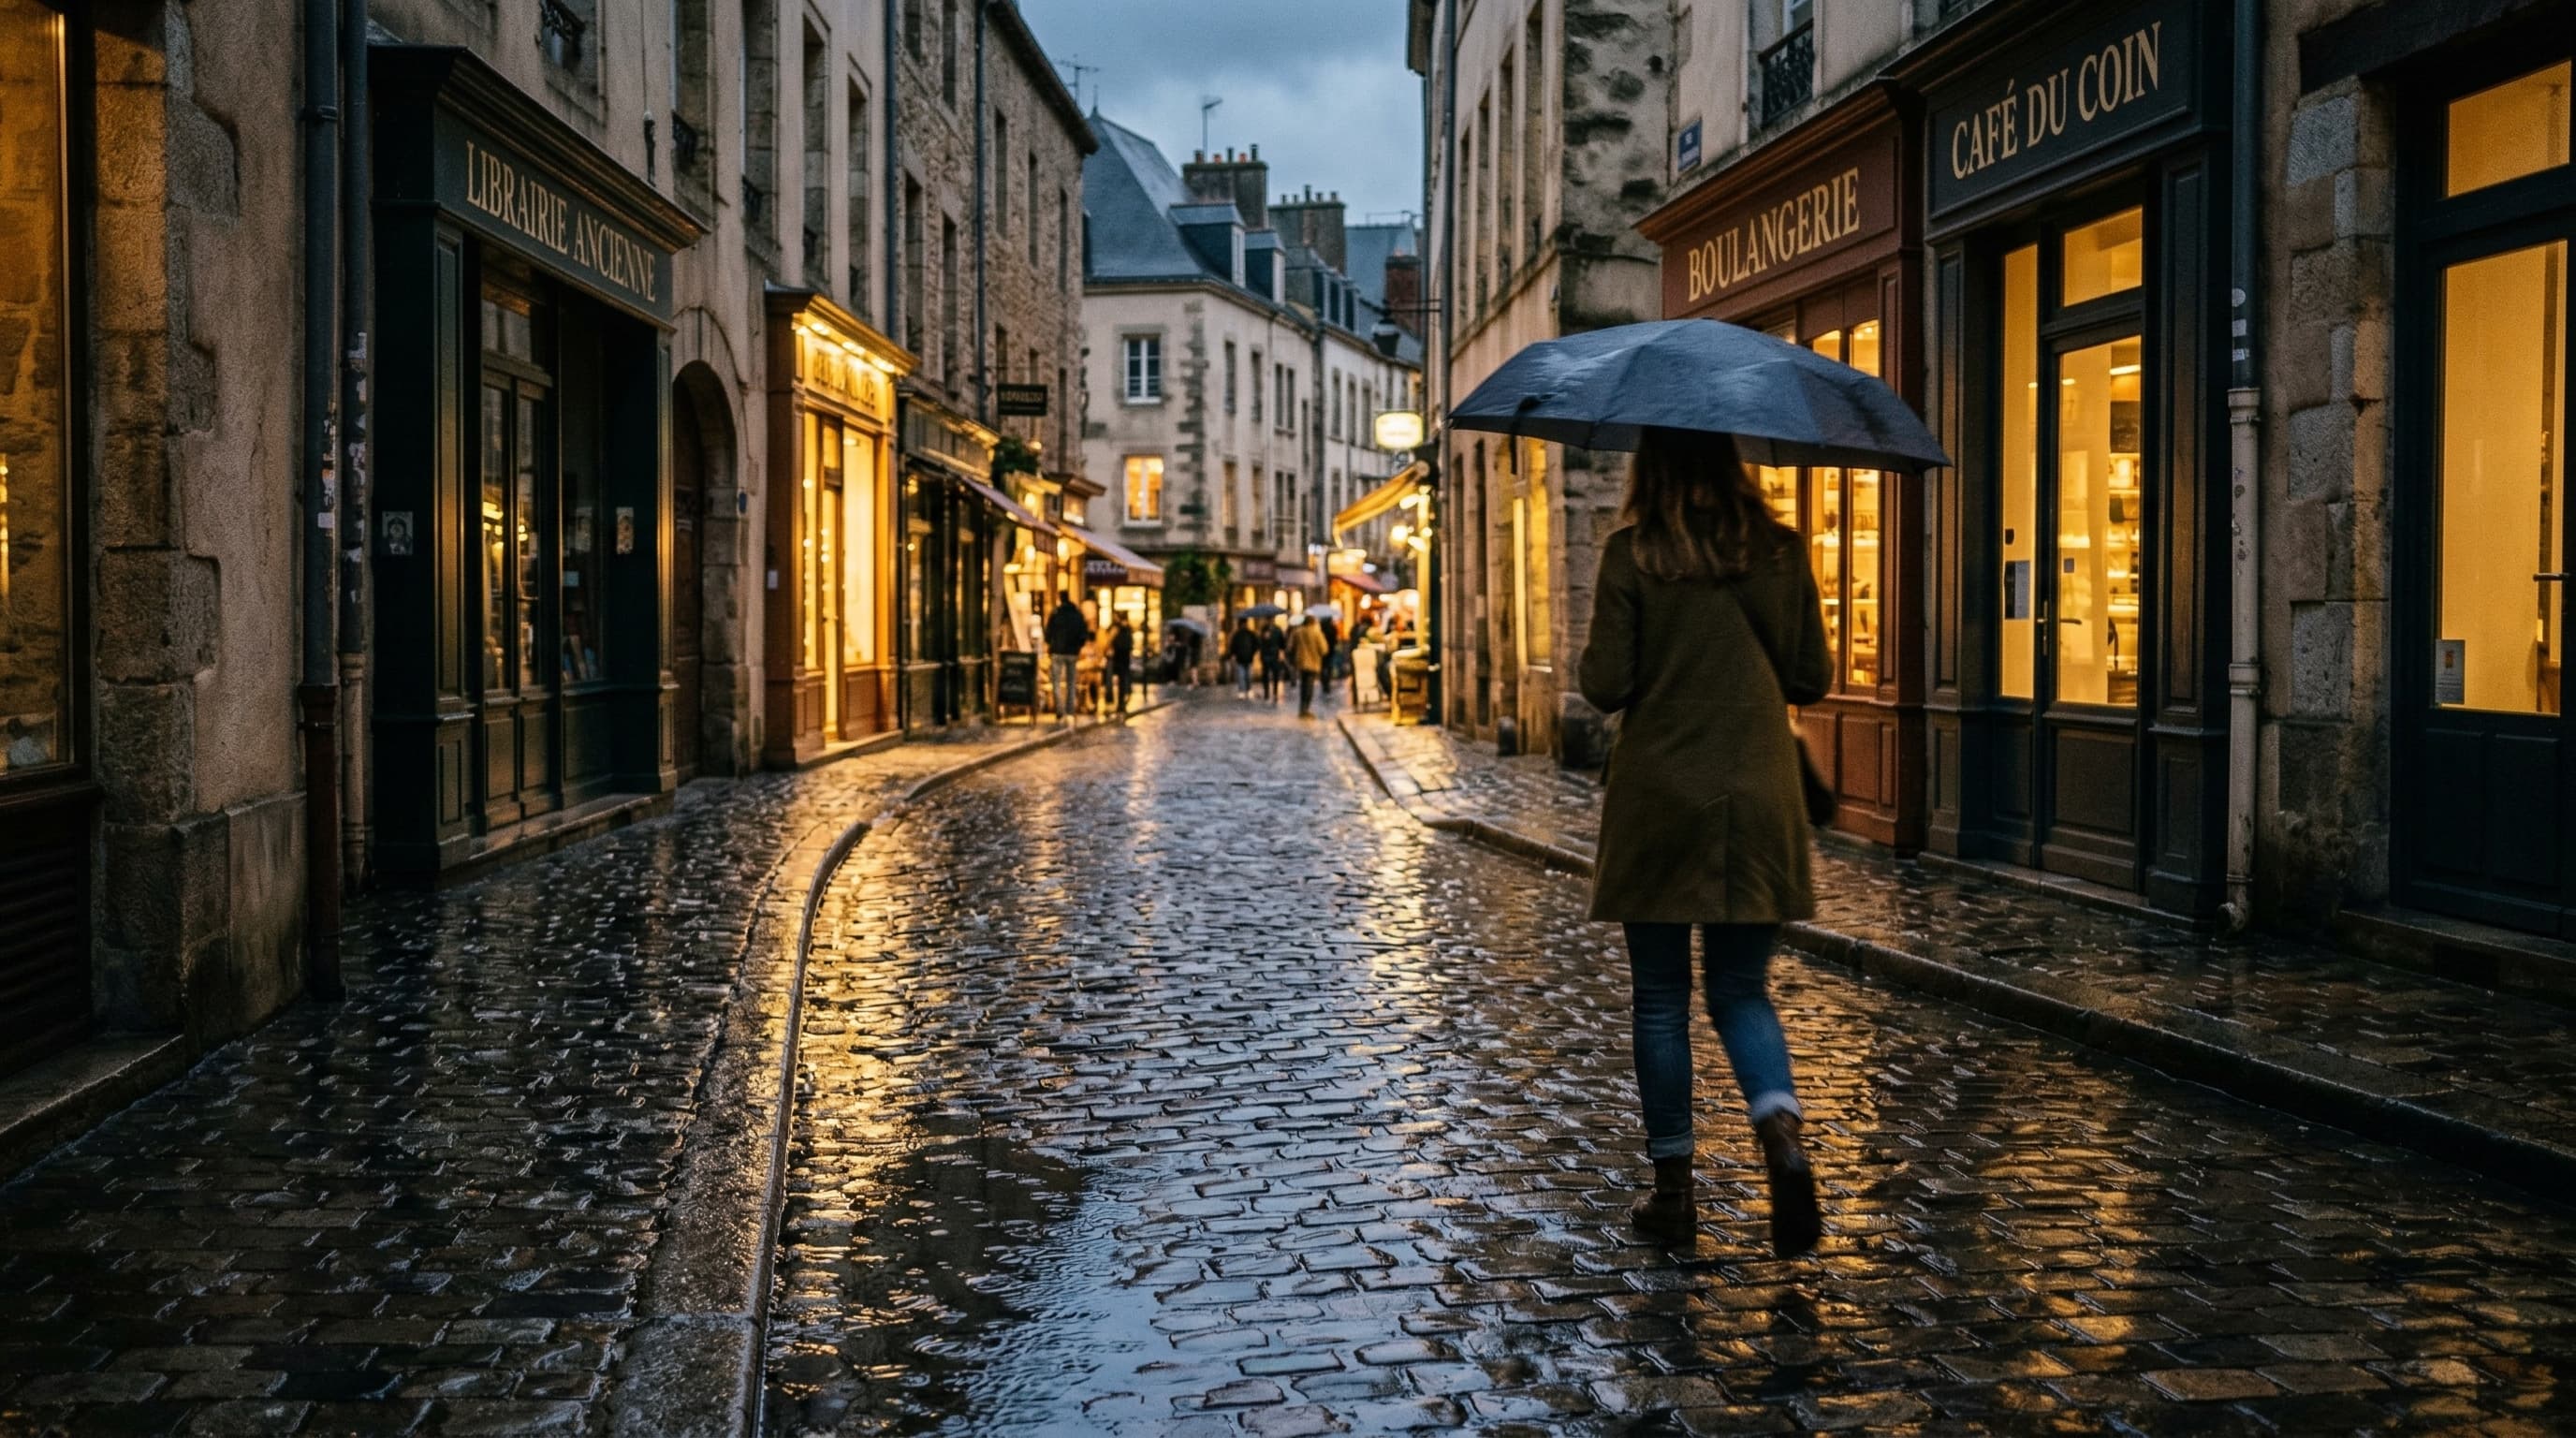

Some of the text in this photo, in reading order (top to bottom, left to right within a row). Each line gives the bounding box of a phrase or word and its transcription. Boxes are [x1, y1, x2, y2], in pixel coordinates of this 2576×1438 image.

[1952, 21, 2161, 180] CAFÉ DU COIN
[467, 141, 655, 302] LIBRAIRIE ANCIENNE
[1688, 168, 1860, 301] BOULANGERIE
